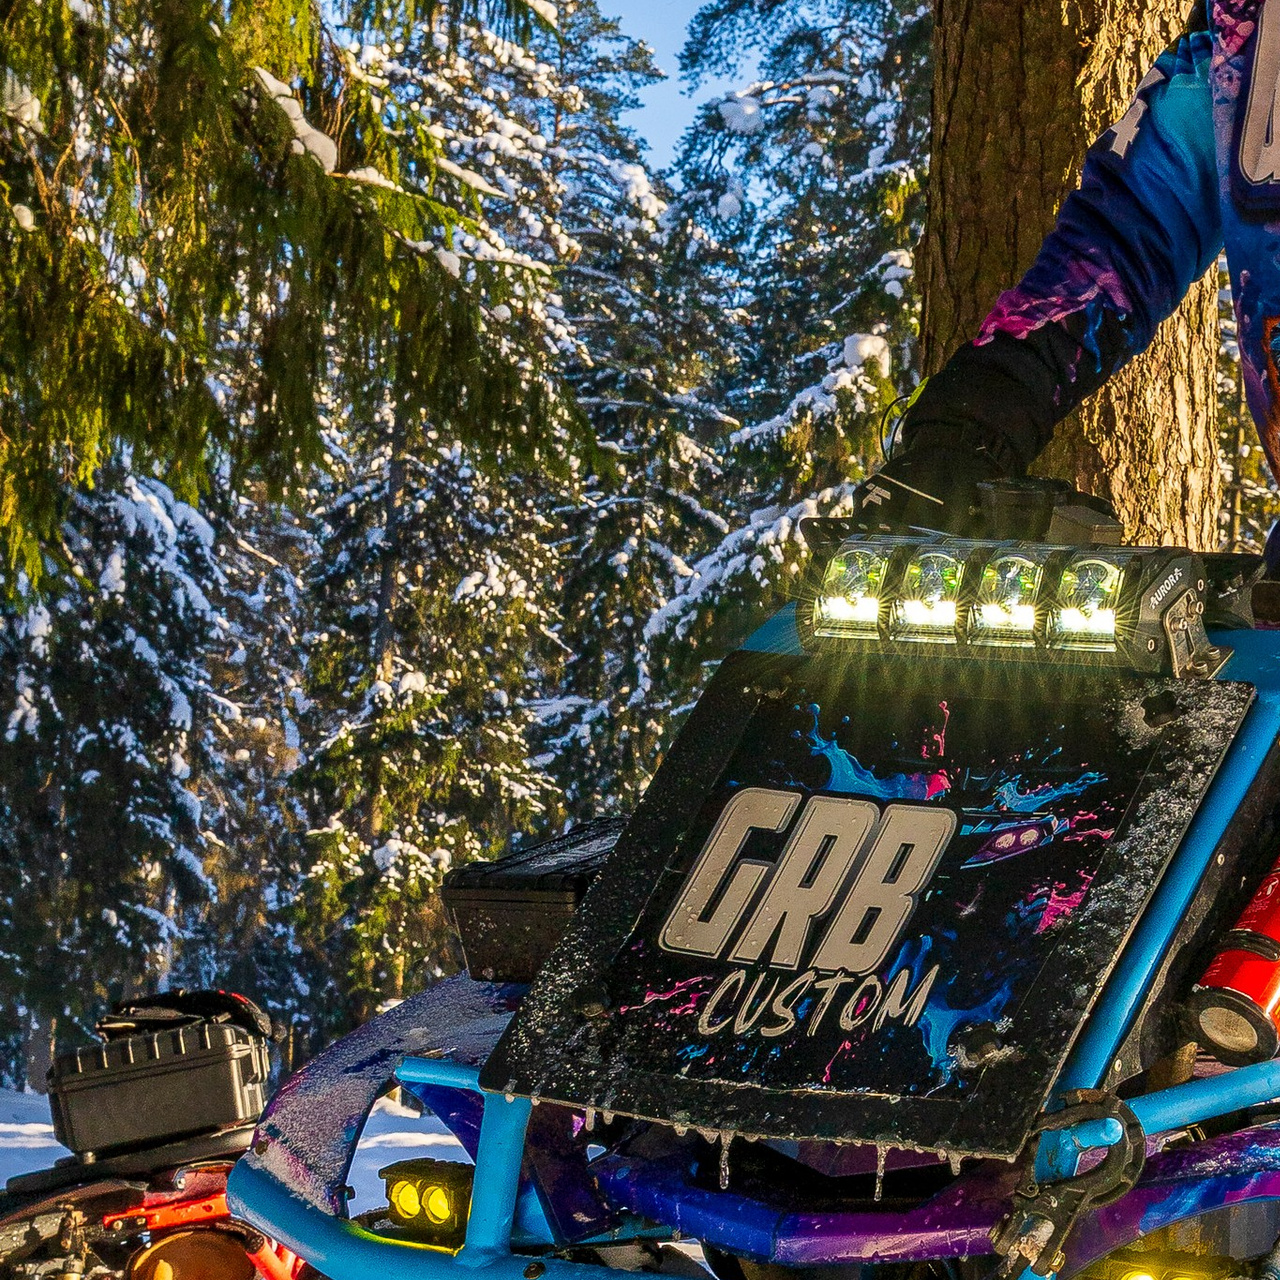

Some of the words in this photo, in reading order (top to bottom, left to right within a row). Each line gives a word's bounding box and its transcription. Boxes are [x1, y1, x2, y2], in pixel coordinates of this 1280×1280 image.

[1149, 567, 1183, 610] AURORA
[658, 787, 957, 976] GRB
[698, 964, 940, 1037] CUSTOM
